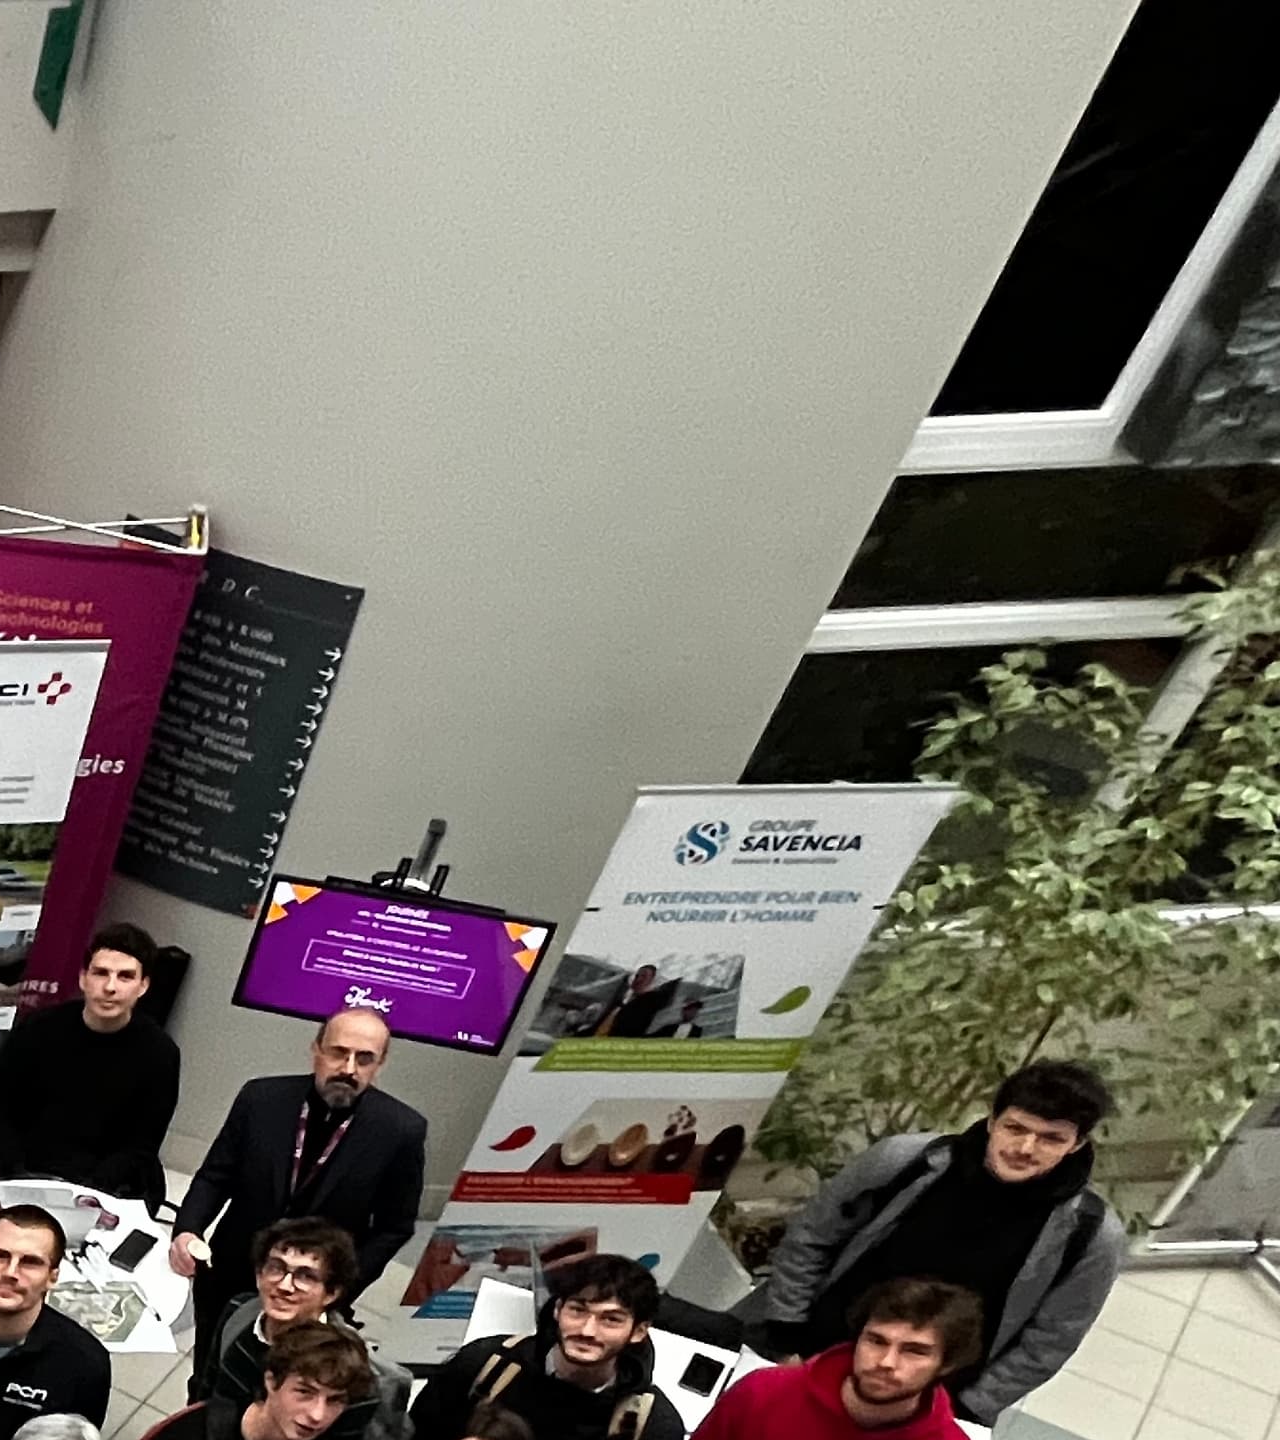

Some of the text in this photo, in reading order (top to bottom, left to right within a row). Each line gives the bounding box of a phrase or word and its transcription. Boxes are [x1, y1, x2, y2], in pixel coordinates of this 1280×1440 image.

[74, 601, 94, 614] et
[748, 819, 818, 833] GROUPE
[739, 834, 863, 852] SAVENCIA
[622, 889, 862, 906] ENTREPRENDRE POUR BIEN
[646, 908, 819, 923] NOURRIR L'HOMME
